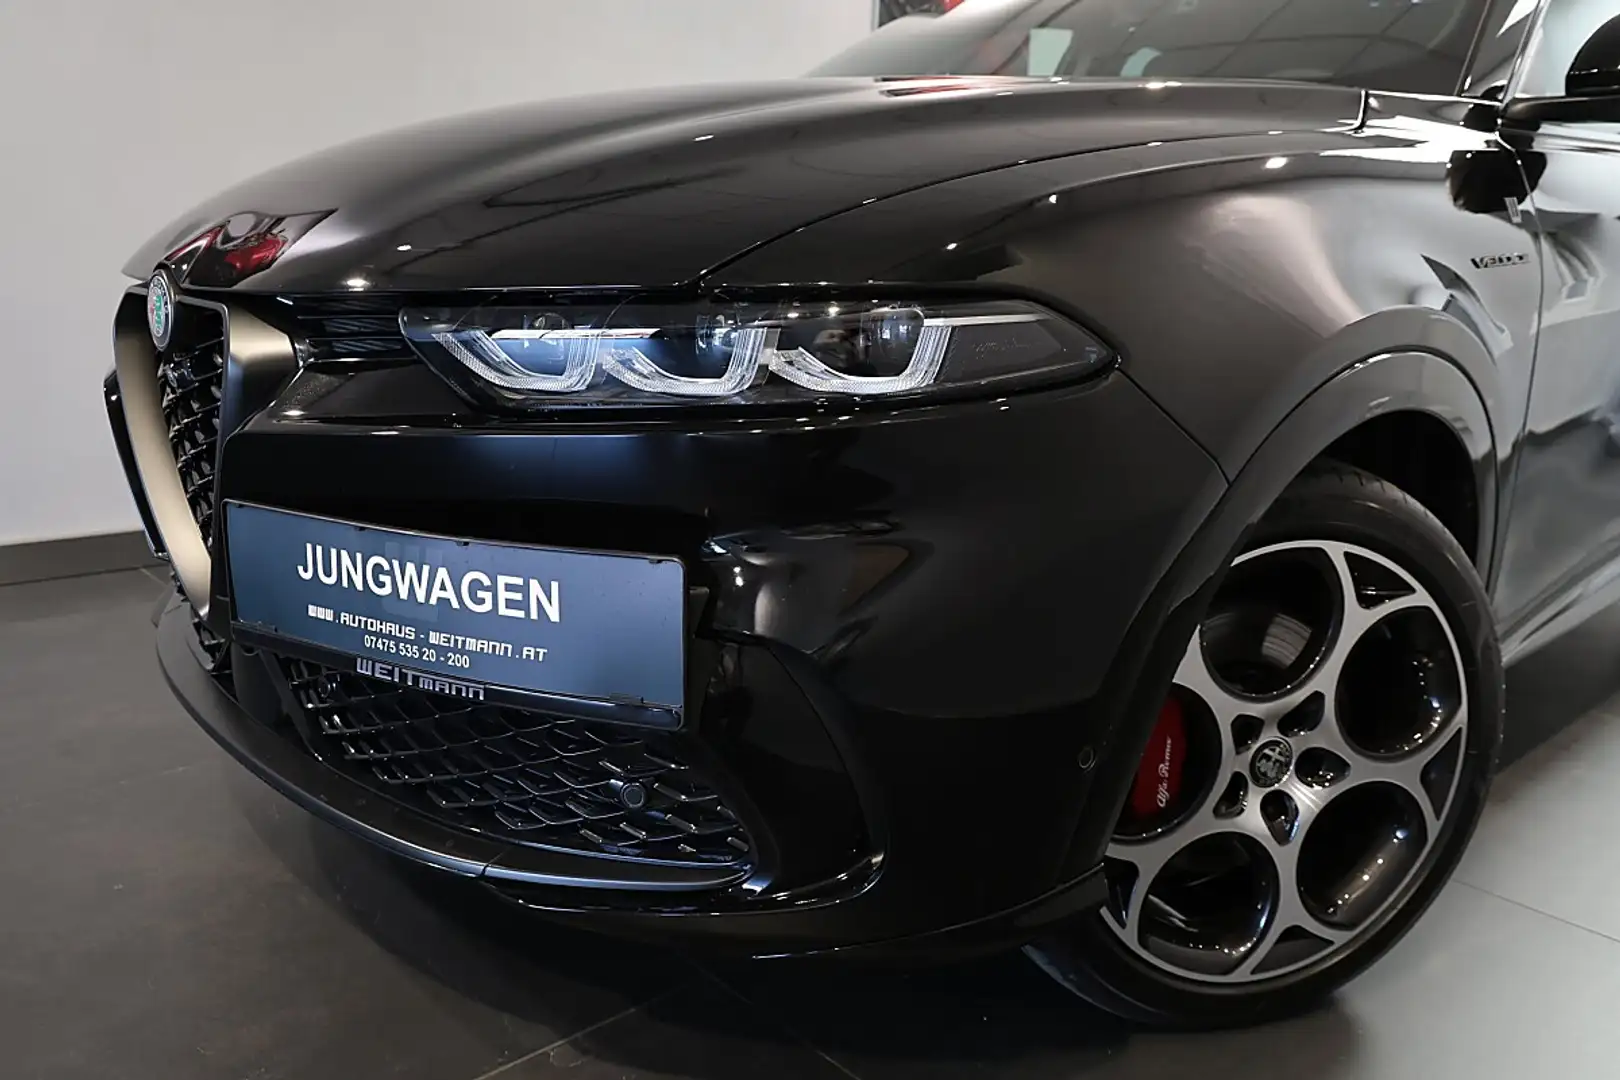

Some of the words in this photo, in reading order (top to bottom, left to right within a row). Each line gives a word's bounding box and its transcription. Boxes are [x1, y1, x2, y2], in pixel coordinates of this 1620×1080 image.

[297, 542, 561, 623] JUNGWAGEN
[364, 634, 397, 653] 07475
[399, 642, 419, 659] 535
[422, 647, 437, 662] 20
[447, 652, 470, 668] 200
[356, 657, 485, 701] WEITMANN
[1156, 779, 1170, 808] Alfa
